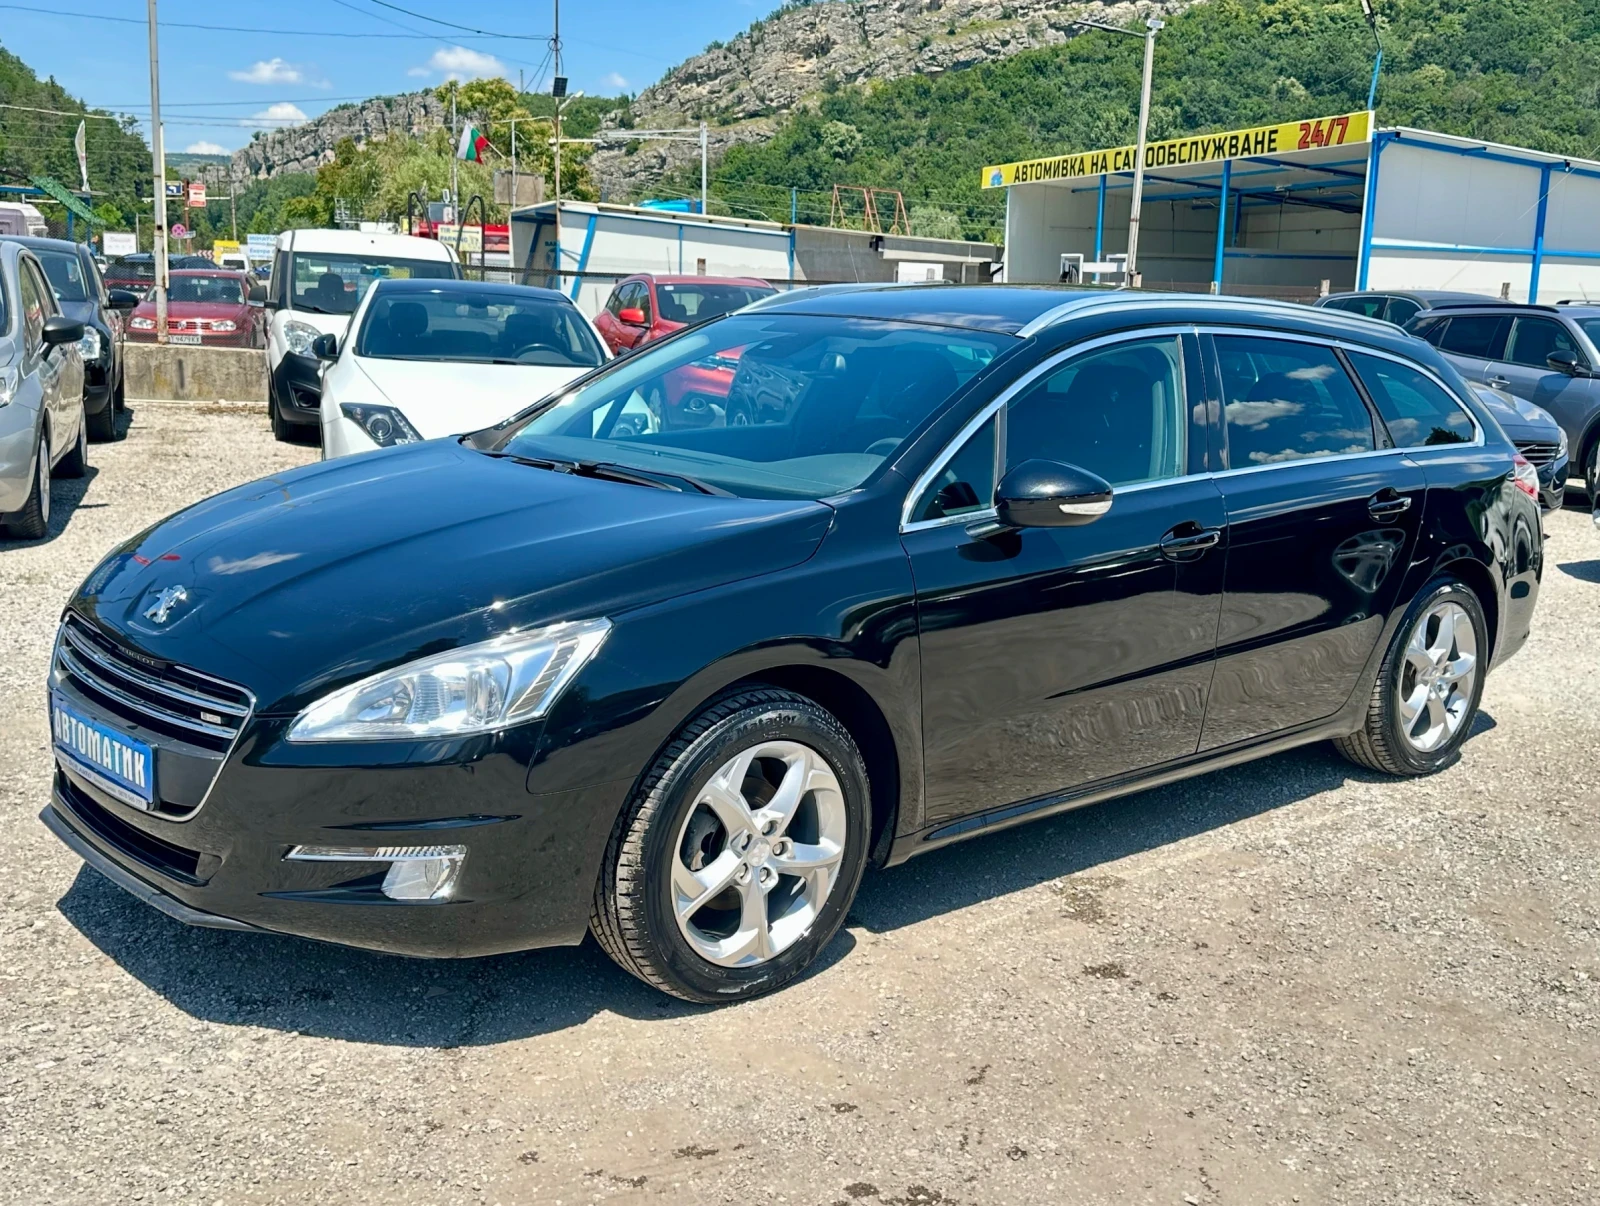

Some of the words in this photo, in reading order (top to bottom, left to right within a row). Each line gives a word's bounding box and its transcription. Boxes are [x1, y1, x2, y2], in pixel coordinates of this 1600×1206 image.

[1013, 157, 1085, 183] АВТОМИВКА
[1090, 153, 1108, 175] НА
[1297, 116, 1350, 150] 24/7
[440, 235, 469, 243] PARKNG
[54, 707, 145, 789] АВТОМАТИК
